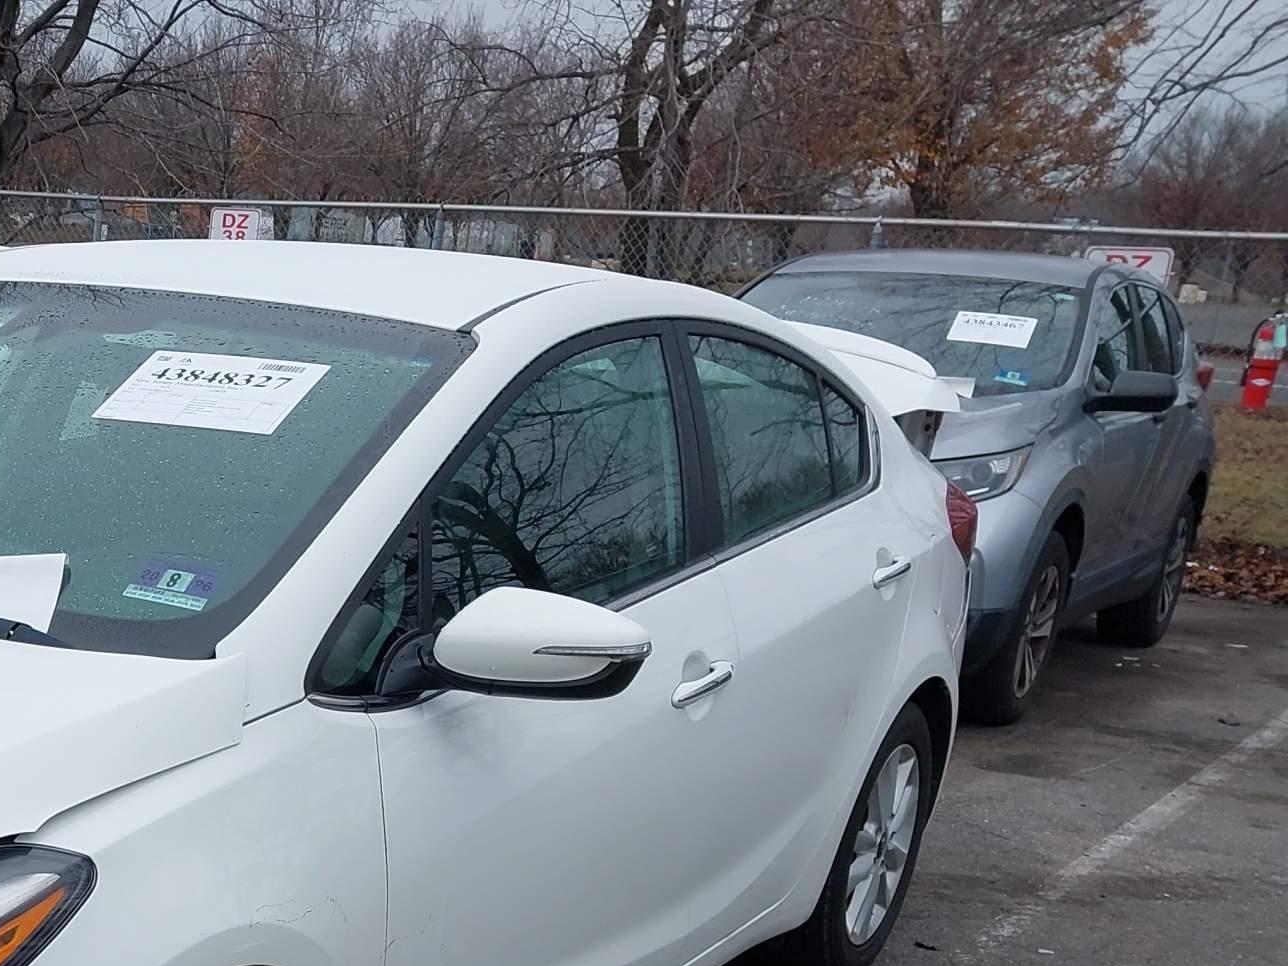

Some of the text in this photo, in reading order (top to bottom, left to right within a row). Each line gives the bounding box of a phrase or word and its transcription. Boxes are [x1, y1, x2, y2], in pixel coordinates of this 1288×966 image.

[222, 213, 250, 229] DZ
[222, 229, 246, 240] 38
[151, 367, 296, 390] 43848327
[141, 568, 160, 581] 20
[166, 572, 182, 588] 8
[195, 578, 213, 592] 26
